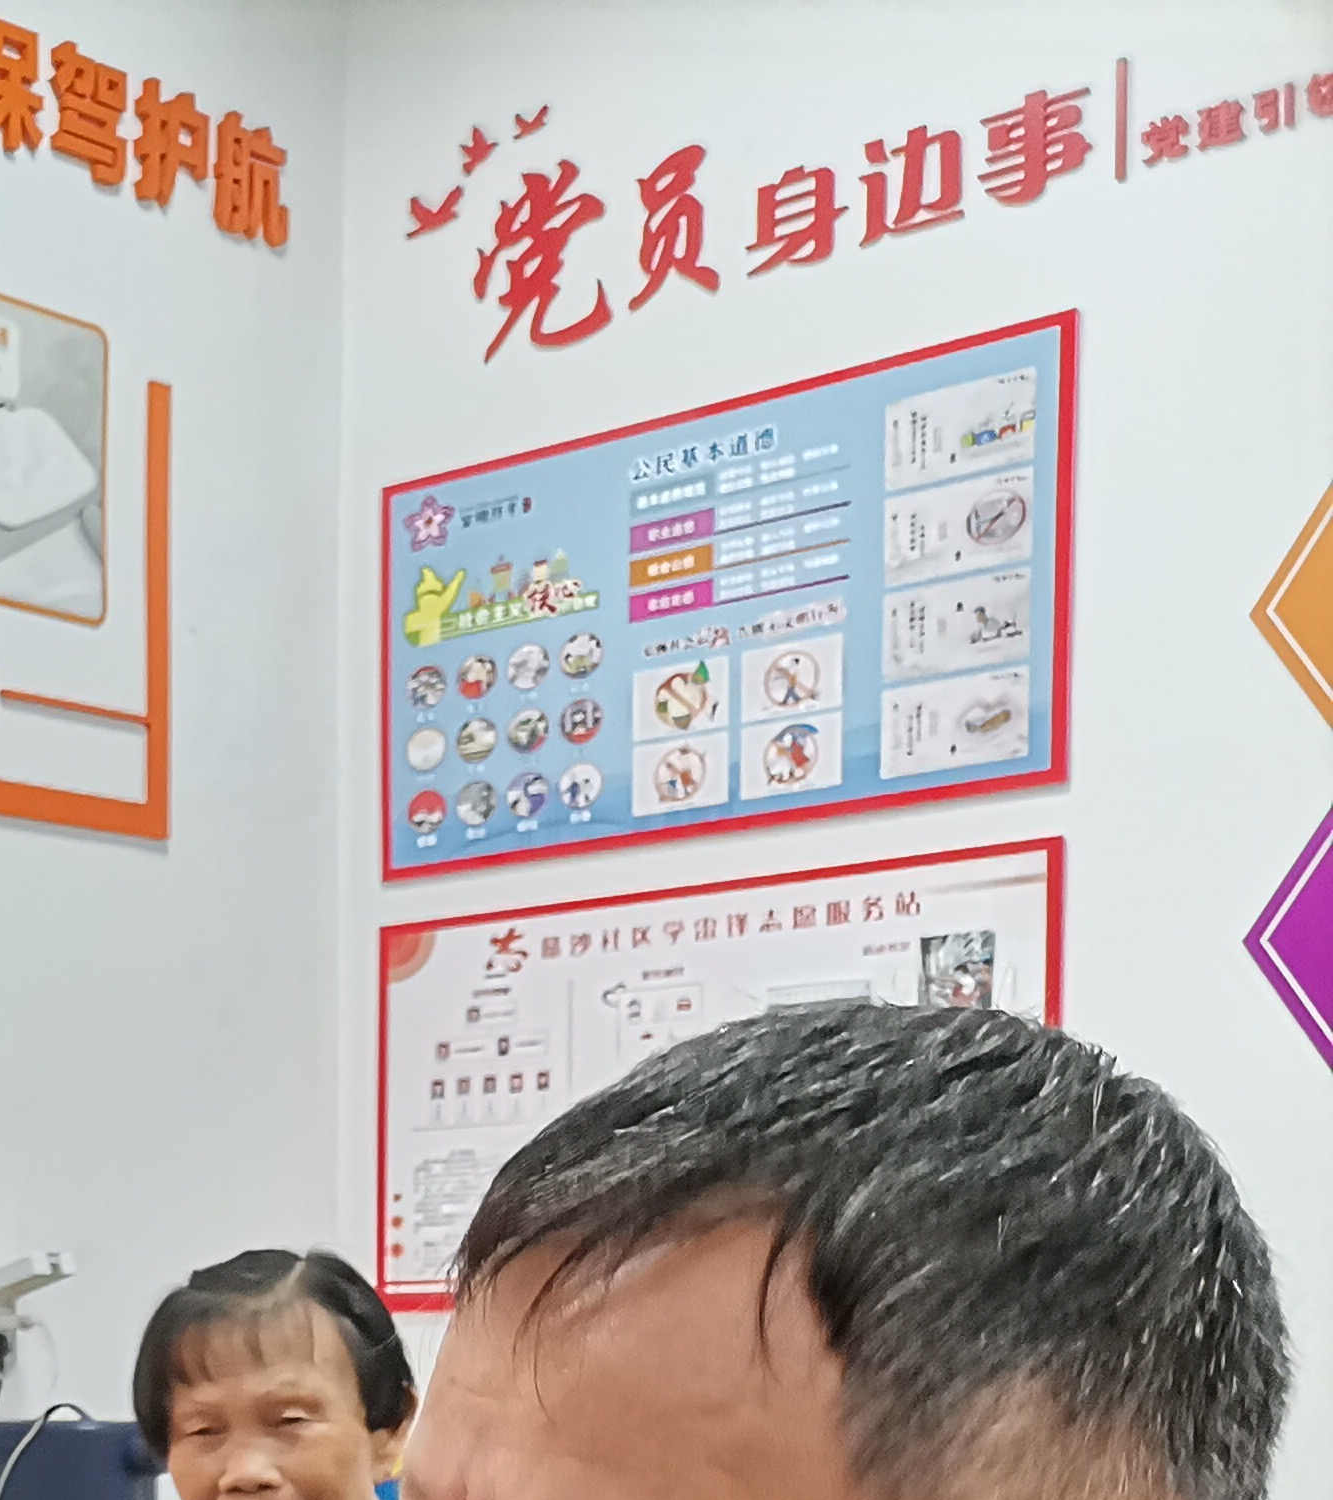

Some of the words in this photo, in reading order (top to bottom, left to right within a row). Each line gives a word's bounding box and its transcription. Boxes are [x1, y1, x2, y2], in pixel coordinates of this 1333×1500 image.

[473, 87, 1095, 364] 党员身边事
